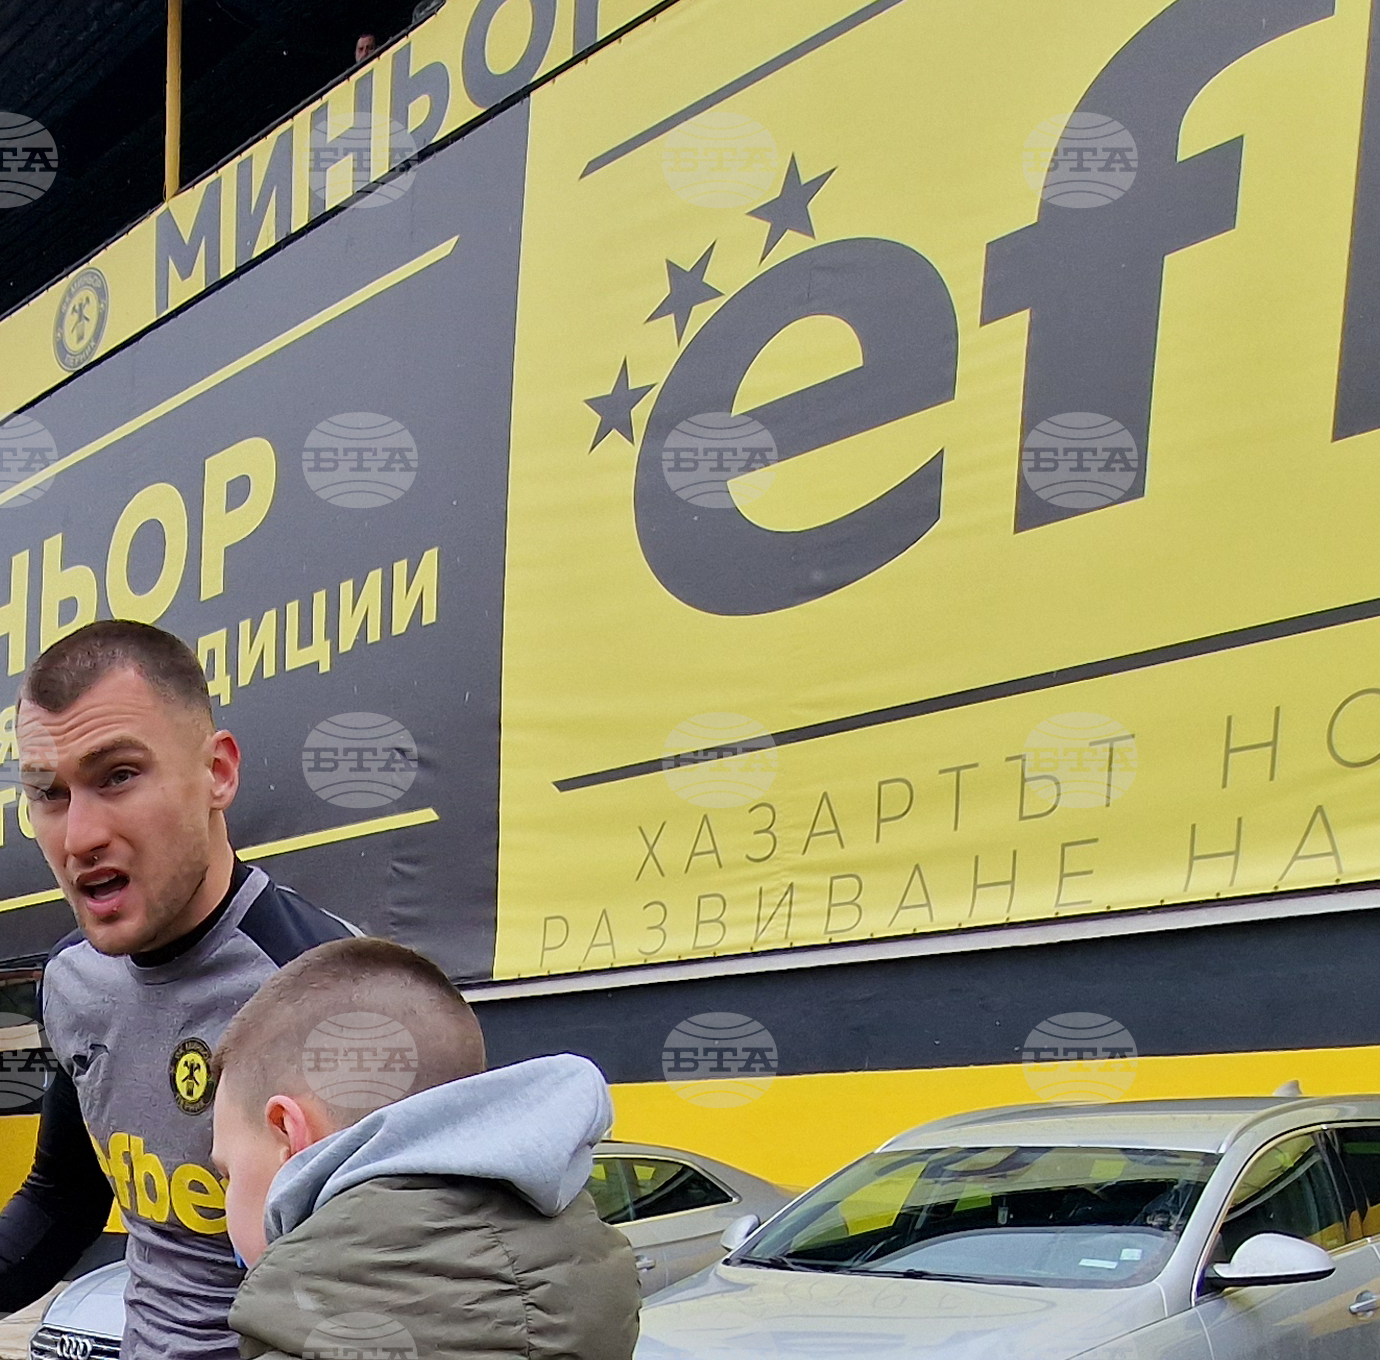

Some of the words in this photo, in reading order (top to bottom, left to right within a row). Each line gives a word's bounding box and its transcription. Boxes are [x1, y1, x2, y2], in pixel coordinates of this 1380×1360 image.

[154, 0, 599, 318] МИНЬО
[632, 0, 1380, 617] ef
[196, 546, 440, 707] ДИЦИИ
[539, 837, 1099, 968] РАЗВИВАНЕ
[1182, 804, 1344, 893] НА
[635, 733, 1136, 882] ХАЗАРТЪТ
[90, 1131, 230, 1235] fbe
